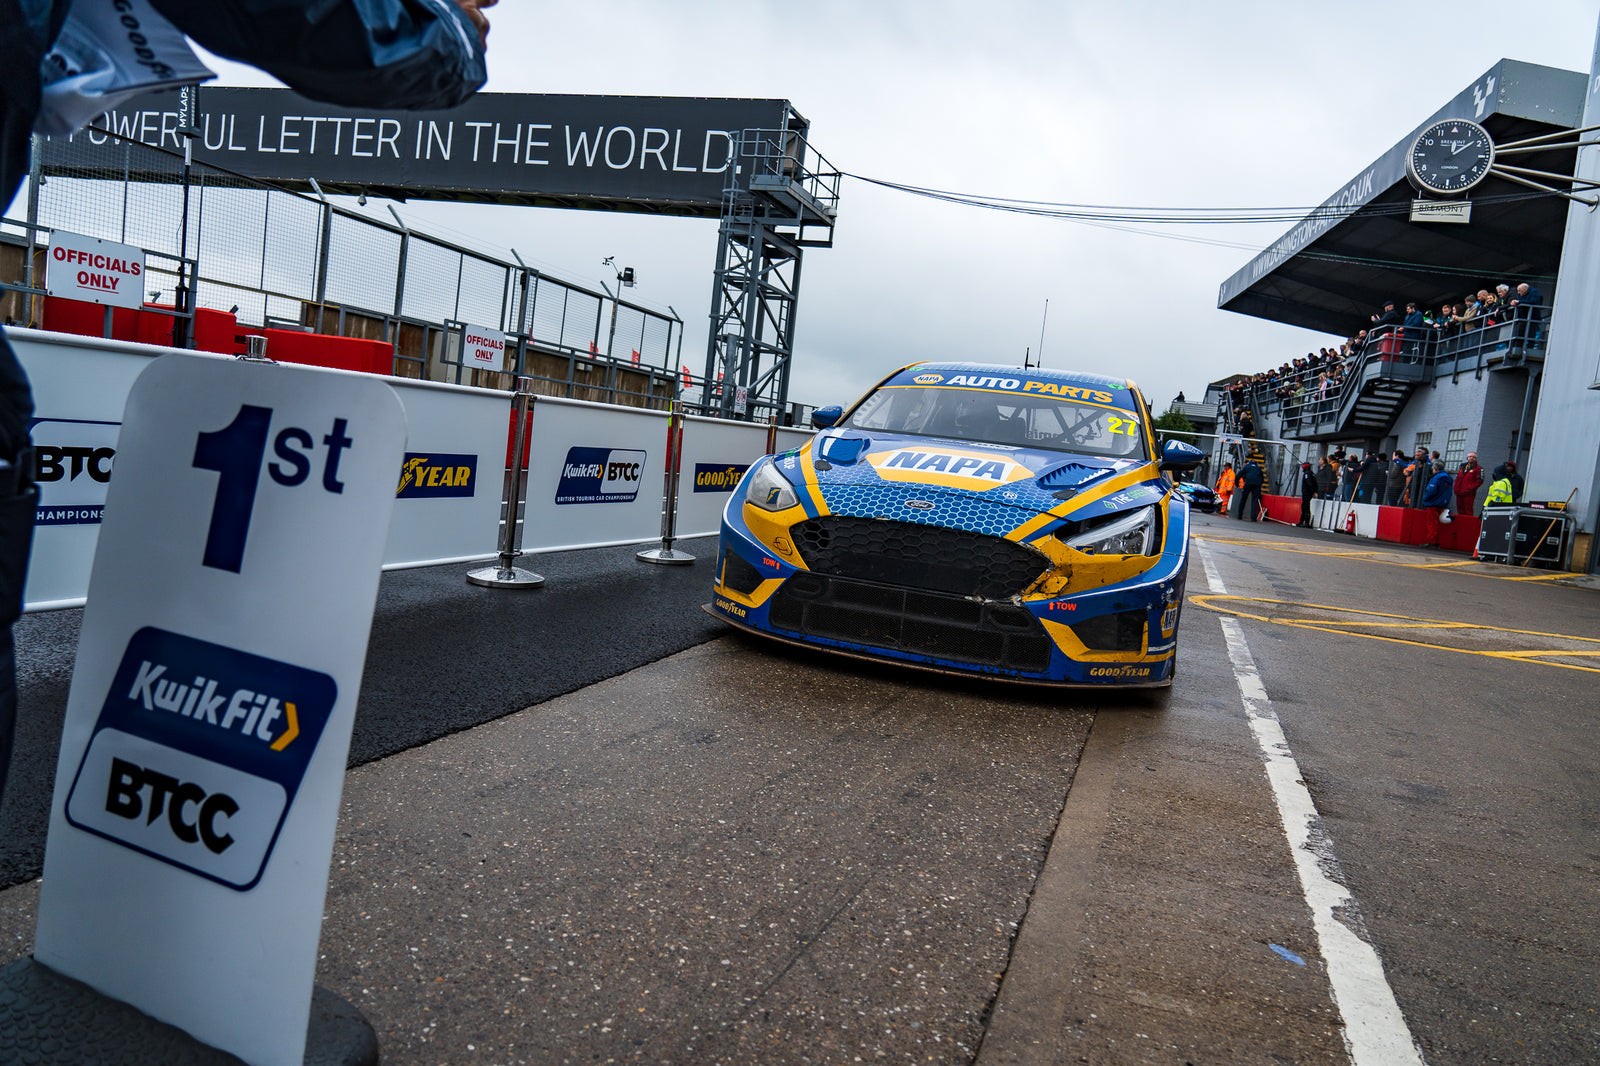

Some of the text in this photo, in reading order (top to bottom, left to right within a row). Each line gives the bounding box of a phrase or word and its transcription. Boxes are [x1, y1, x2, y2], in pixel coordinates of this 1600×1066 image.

[178, 85, 189, 128] MYLAPS
[69, 111, 742, 174] OWERUL LETTER IN THE WORLD.
[1425, 138, 1434, 146] 10
[53, 246, 141, 276] OFFICIALS
[77, 270, 120, 290] ONLY
[466, 334, 504, 350] OFFICIALS
[475, 348, 494, 360] ONLY
[946, 375, 1021, 390] AUTO
[1023, 380, 1113, 403] PARTS
[1108, 416, 1136, 436] 27
[35, 445, 116, 483] BTC
[607, 462, 640, 481] BTCC
[886, 451, 1007, 480] NAPA
[191, 403, 353, 575] 1st
[763, 557, 776, 567] TOW
[716, 598, 746, 618] GOODYEAR
[1056, 601, 1077, 611] TOW
[1090, 666, 1150, 677] GOODYEAR
[105, 756, 240, 855] BTCC
